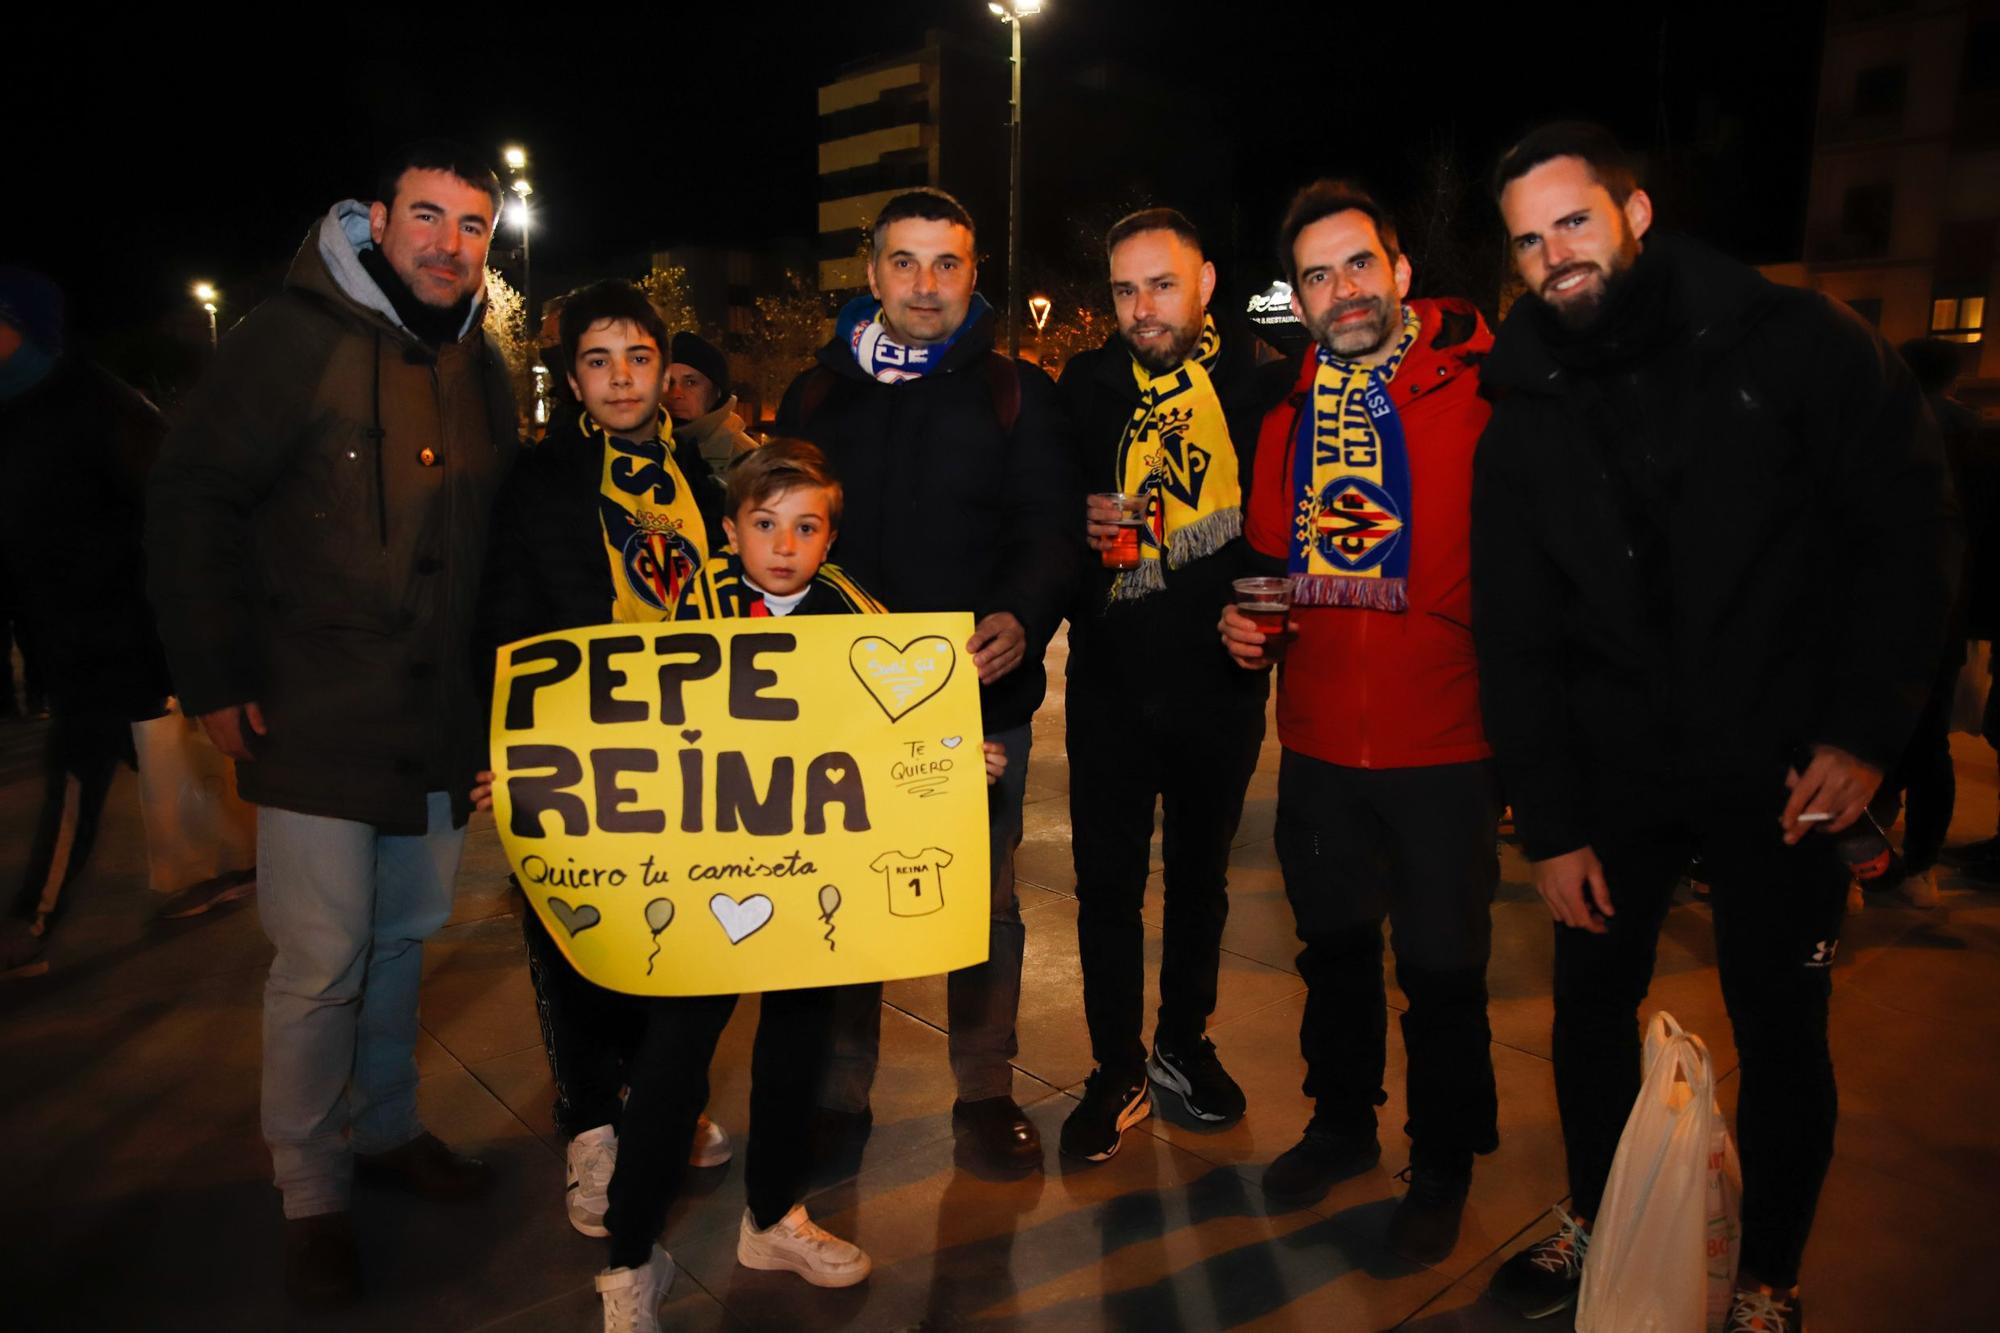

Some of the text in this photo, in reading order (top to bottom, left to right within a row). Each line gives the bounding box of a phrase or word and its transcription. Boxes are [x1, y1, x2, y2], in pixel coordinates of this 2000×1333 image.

[504, 632, 800, 731] PEPE
[903, 741, 926, 758] TE
[890, 758, 954, 781] QUIERO
[505, 730, 872, 839] REINA
[520, 849, 818, 889] Quiero tu camiseta
[896, 864, 929, 875] REINA
[908, 877, 922, 898] 1
